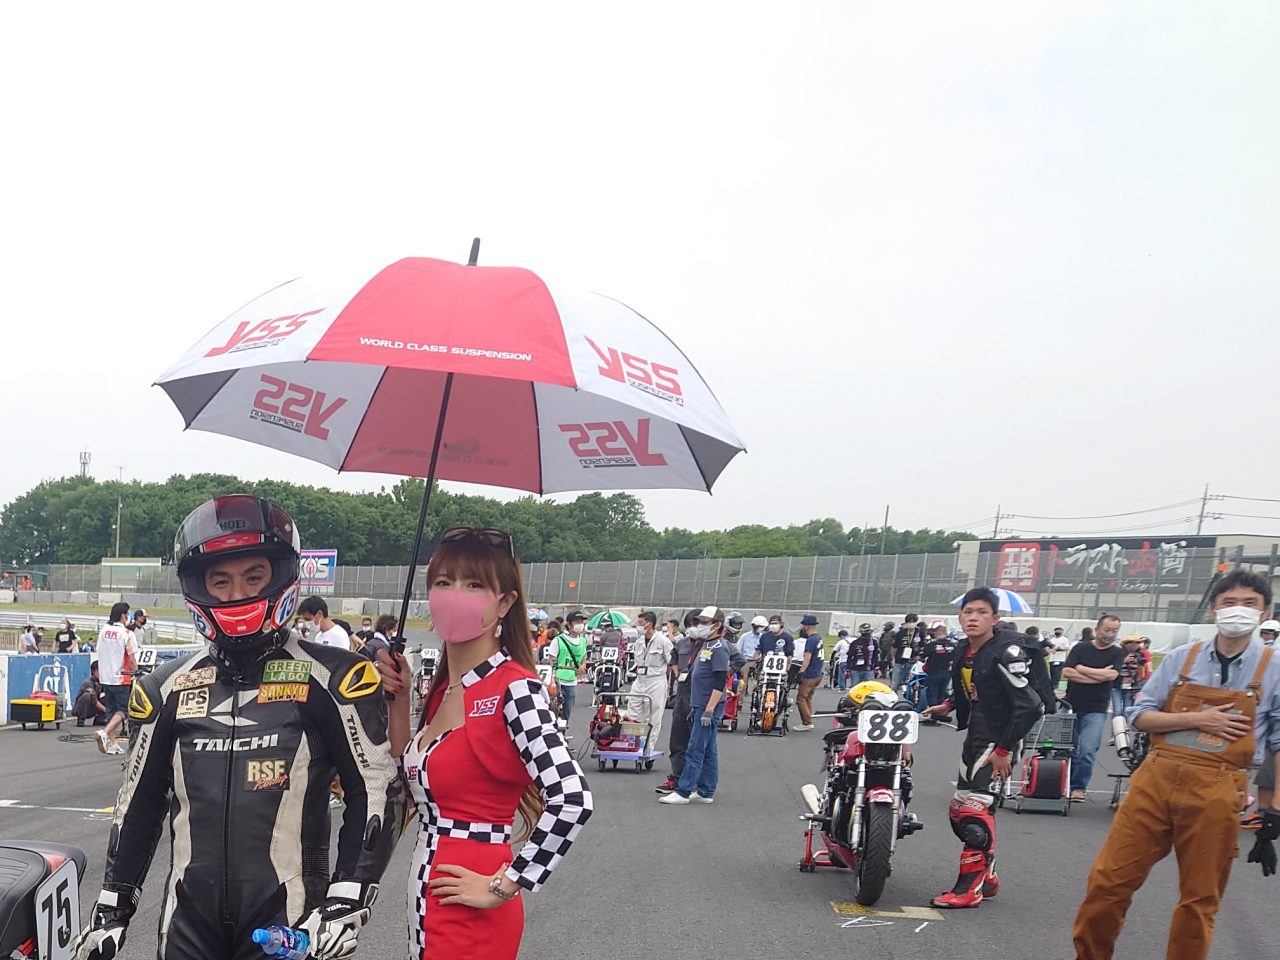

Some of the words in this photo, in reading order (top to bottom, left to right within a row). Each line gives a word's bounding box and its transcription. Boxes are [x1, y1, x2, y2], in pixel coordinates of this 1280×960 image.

[359, 337, 404, 349] WORLD
[406, 342, 448, 353] CLASS
[450, 347, 532, 361] SUSPENSION
[218, 519, 247, 531] HOEI
[104, 630, 118, 638] RK
[138, 650, 153, 664] 18
[603, 649, 617, 658] 63
[267, 661, 310, 672] GREEN
[765, 657, 785, 671] 48
[260, 683, 307, 697] SANKYO
[180, 690, 208, 707] IPS
[867, 712, 912, 742] 88
[192, 733, 280, 752] TAICHI
[346, 714, 371, 769] TAICHI
[128, 731, 149, 783] TAICHI
